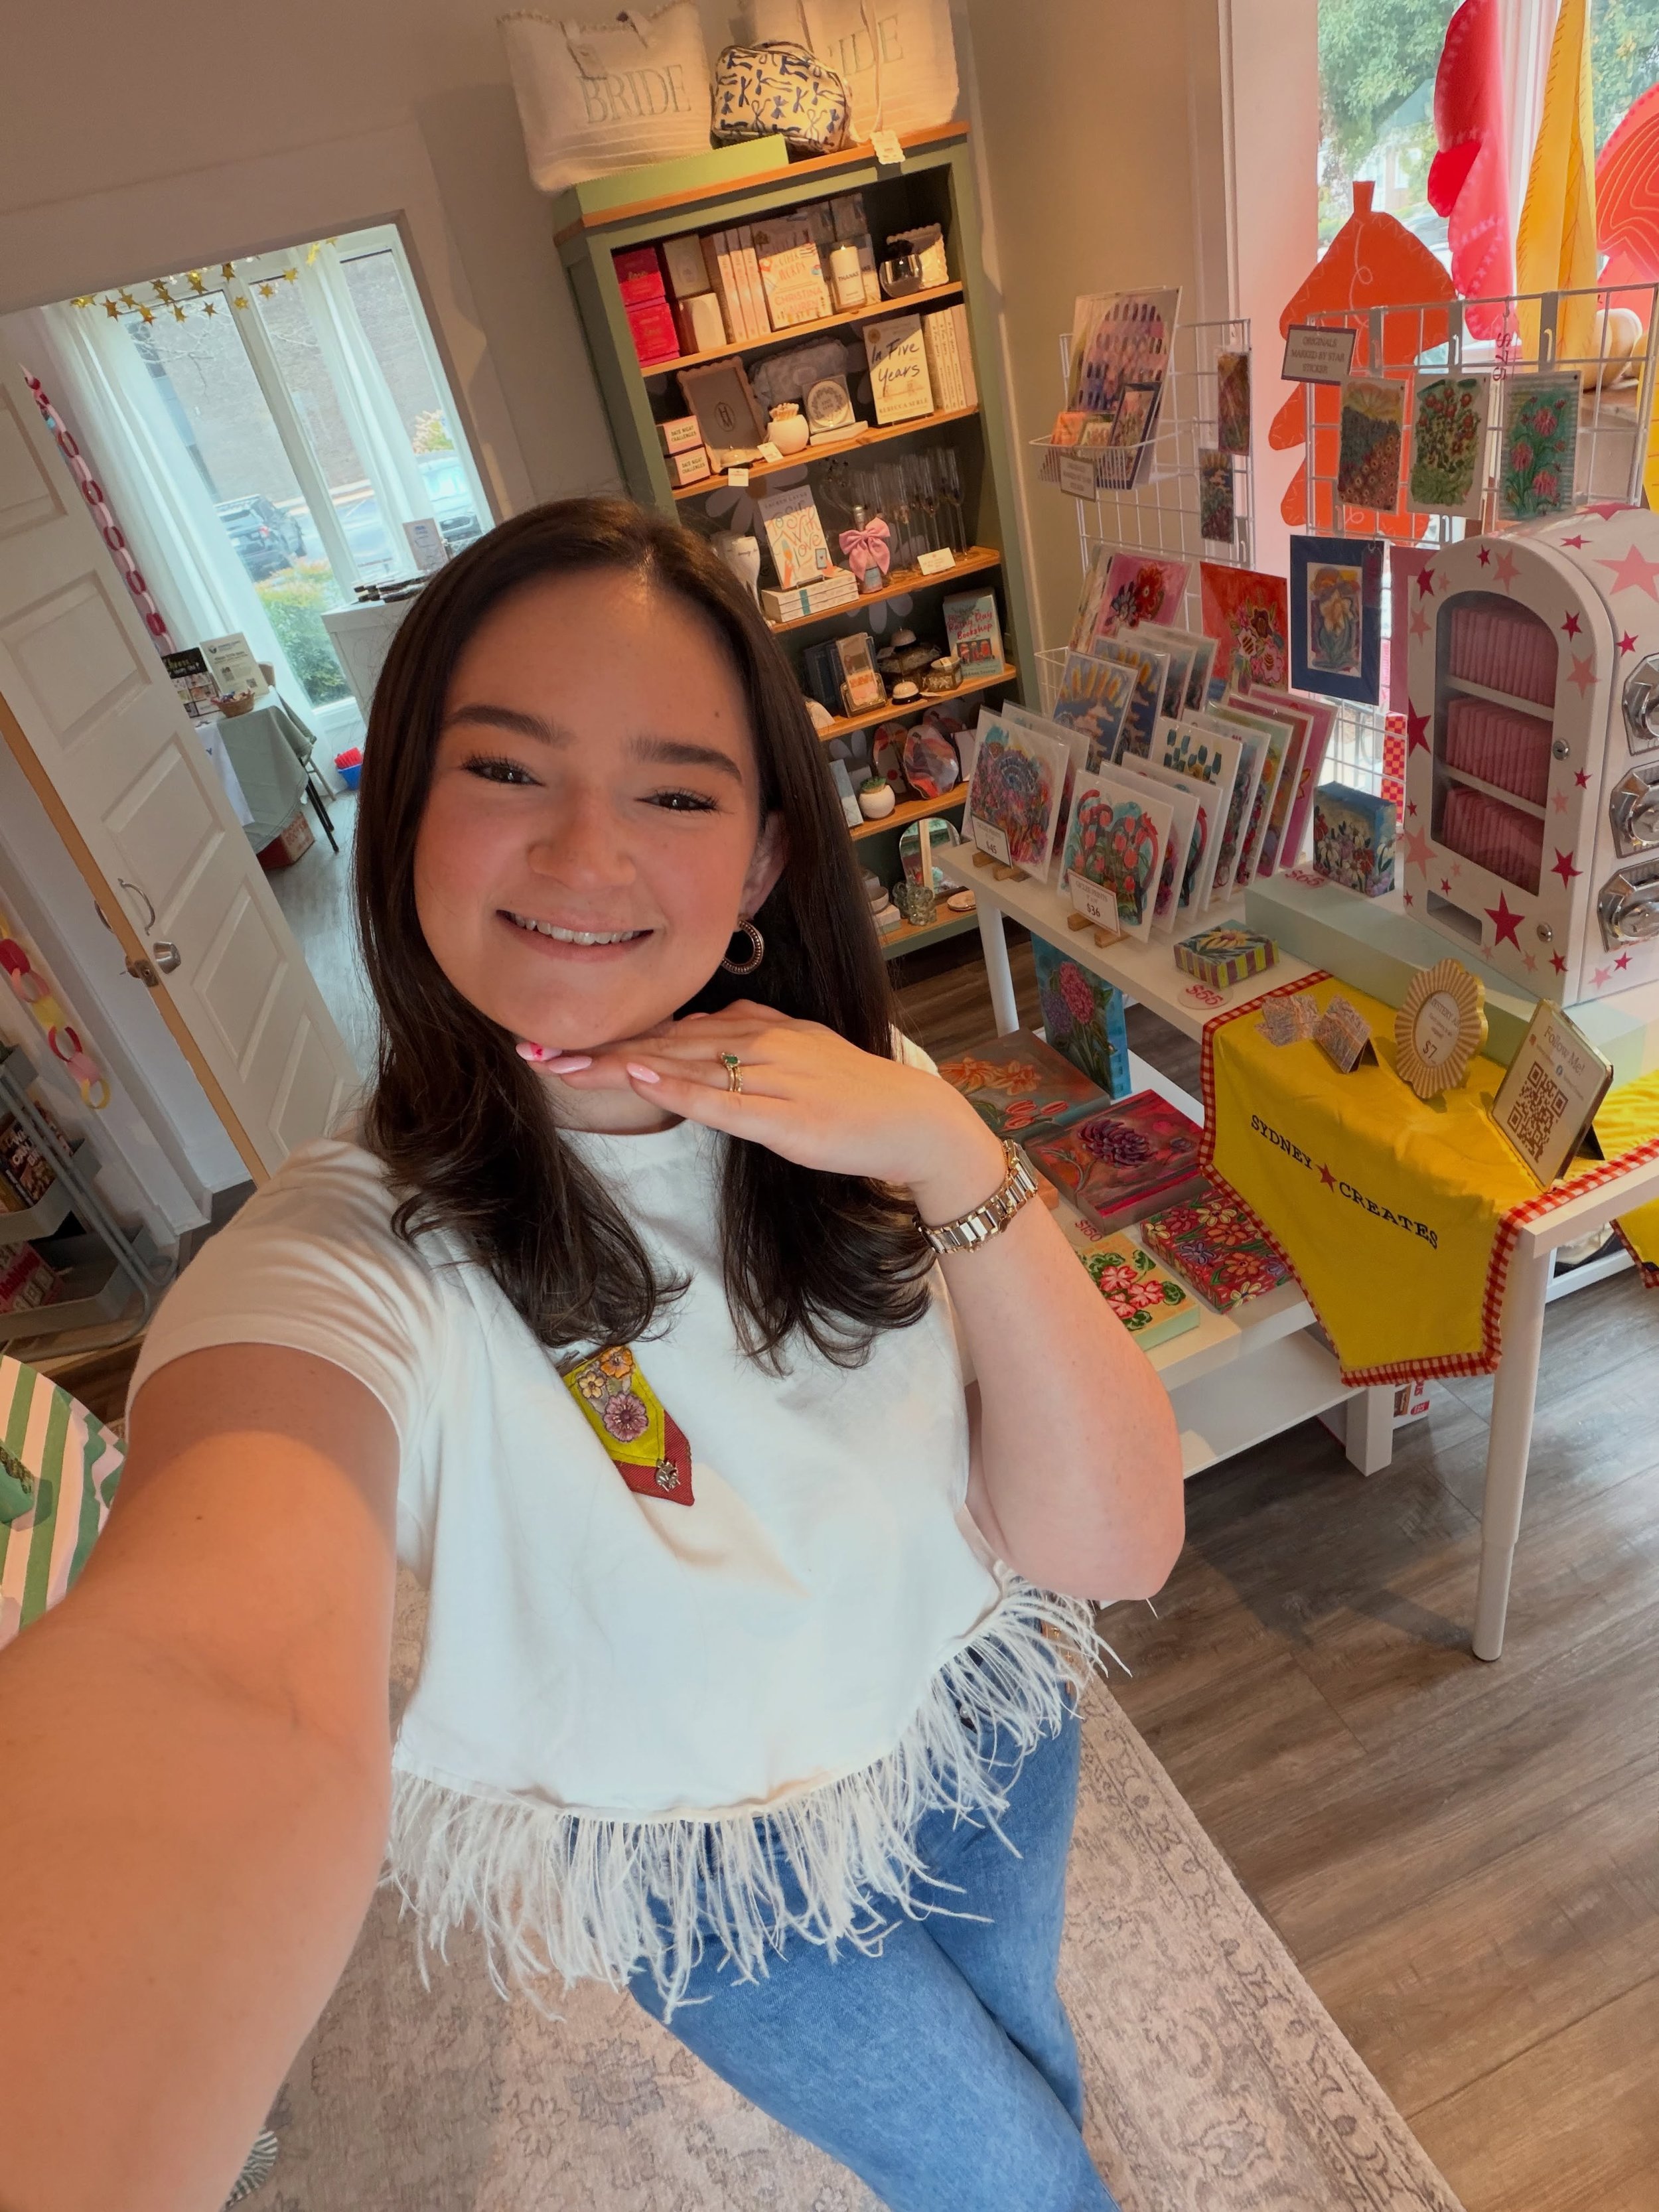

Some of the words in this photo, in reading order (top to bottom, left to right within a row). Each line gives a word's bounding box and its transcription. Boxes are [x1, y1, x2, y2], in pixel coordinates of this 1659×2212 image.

[576, 64, 691, 123] BRIDE
[871, 344, 882, 365] In
[886, 338, 920, 360] Five
[1318, 351, 1327, 360] BY
[878, 364, 920, 398] Years
[974, 611, 993, 623] Day
[957, 623, 993, 640] Bookshop
[1086, 903, 1101, 917] $36
[1185, 984, 1224, 1005] $55
[1422, 1040, 1438, 1059] $7
[1544, 1025, 1569, 1059] Follow
[1568, 1051, 1585, 1076] Me!
[1251, 1114, 1313, 1170] SYDNEY
[1339, 1181, 1438, 1250] CREATES
